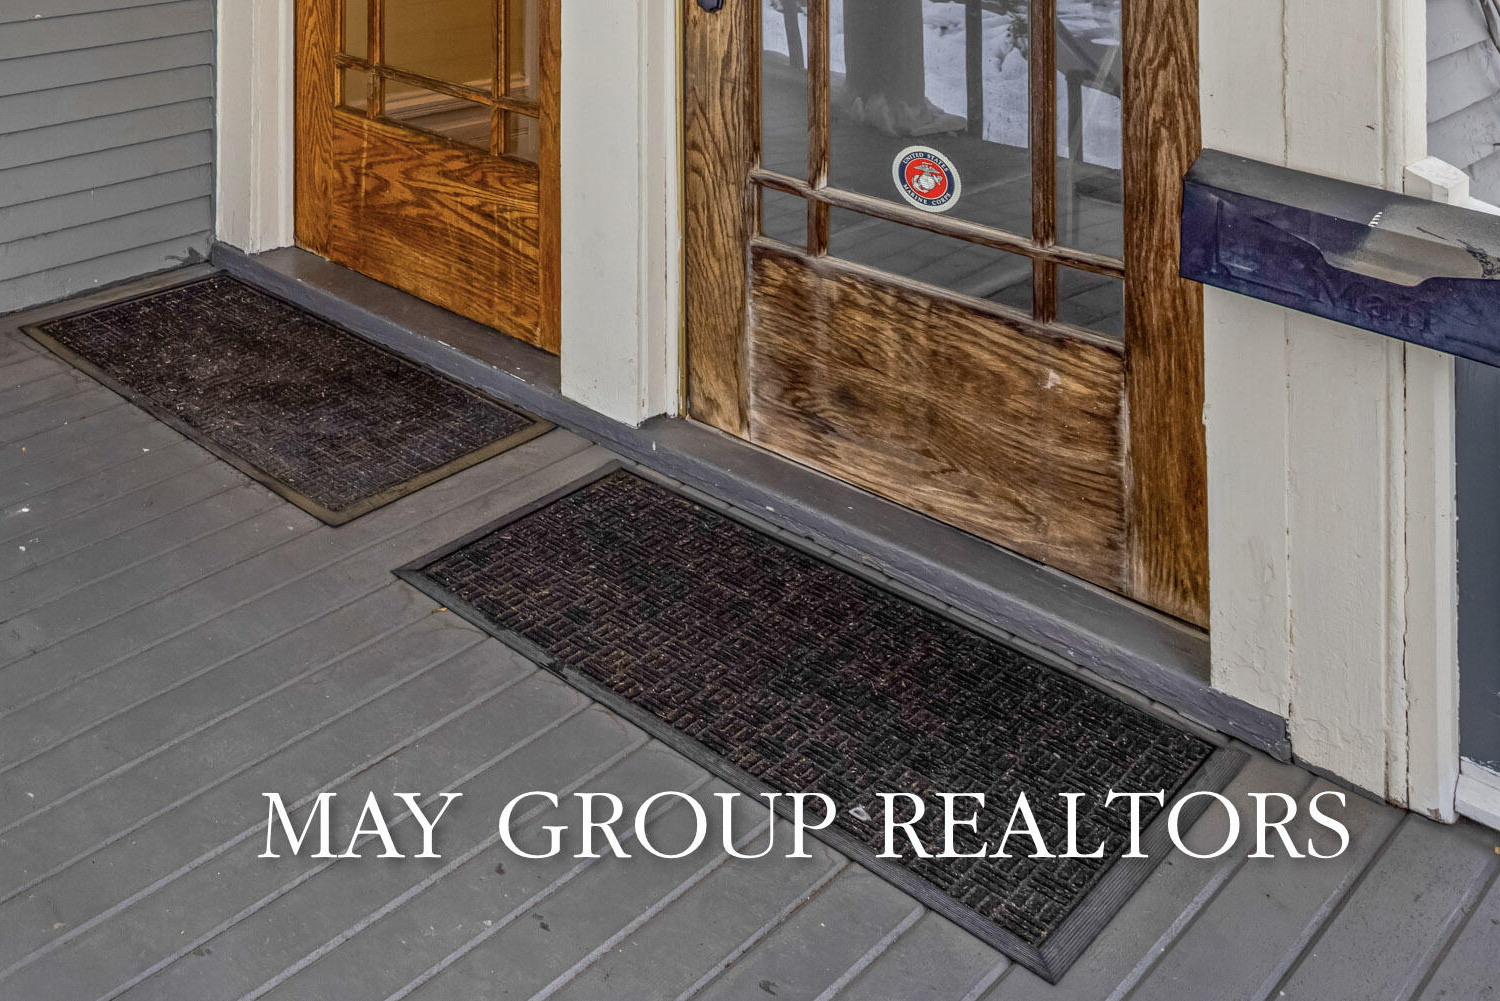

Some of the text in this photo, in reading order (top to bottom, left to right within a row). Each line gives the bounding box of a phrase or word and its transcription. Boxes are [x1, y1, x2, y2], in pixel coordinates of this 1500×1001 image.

[902, 152, 949, 172] UNITED STATES
[903, 184, 952, 206] MARINE CORPS
